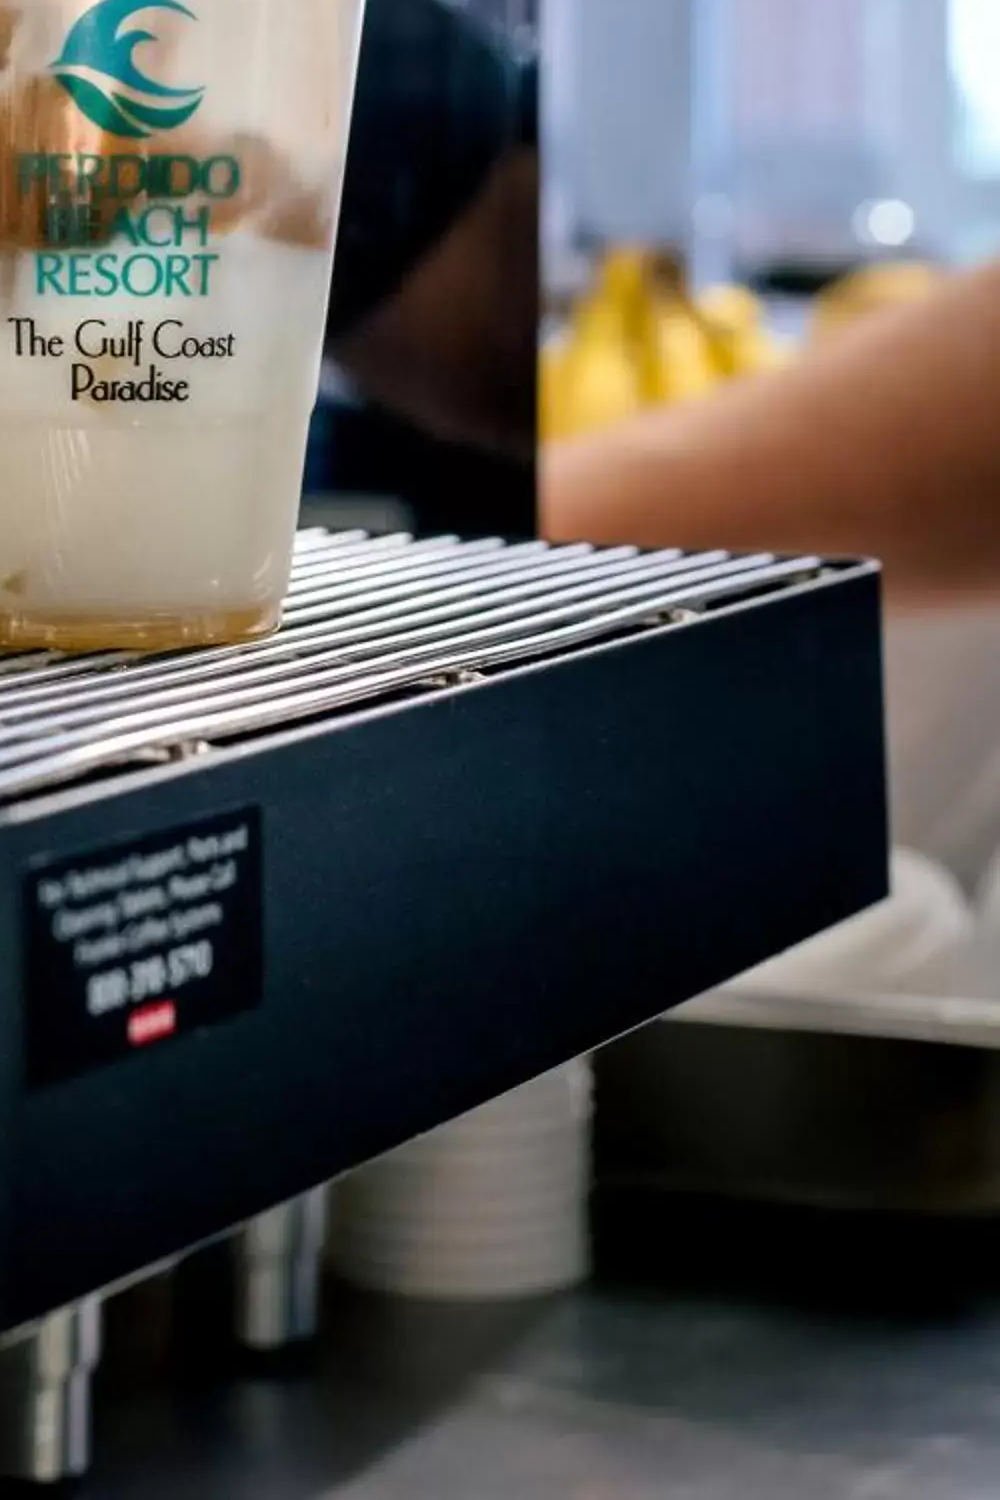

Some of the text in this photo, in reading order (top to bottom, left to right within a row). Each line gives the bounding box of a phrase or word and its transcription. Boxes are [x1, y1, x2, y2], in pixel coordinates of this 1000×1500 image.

[35, 253, 219, 297] RESORT
[8, 317, 236, 367] The Gulf Coast
[71, 361, 190, 402] Paradise
